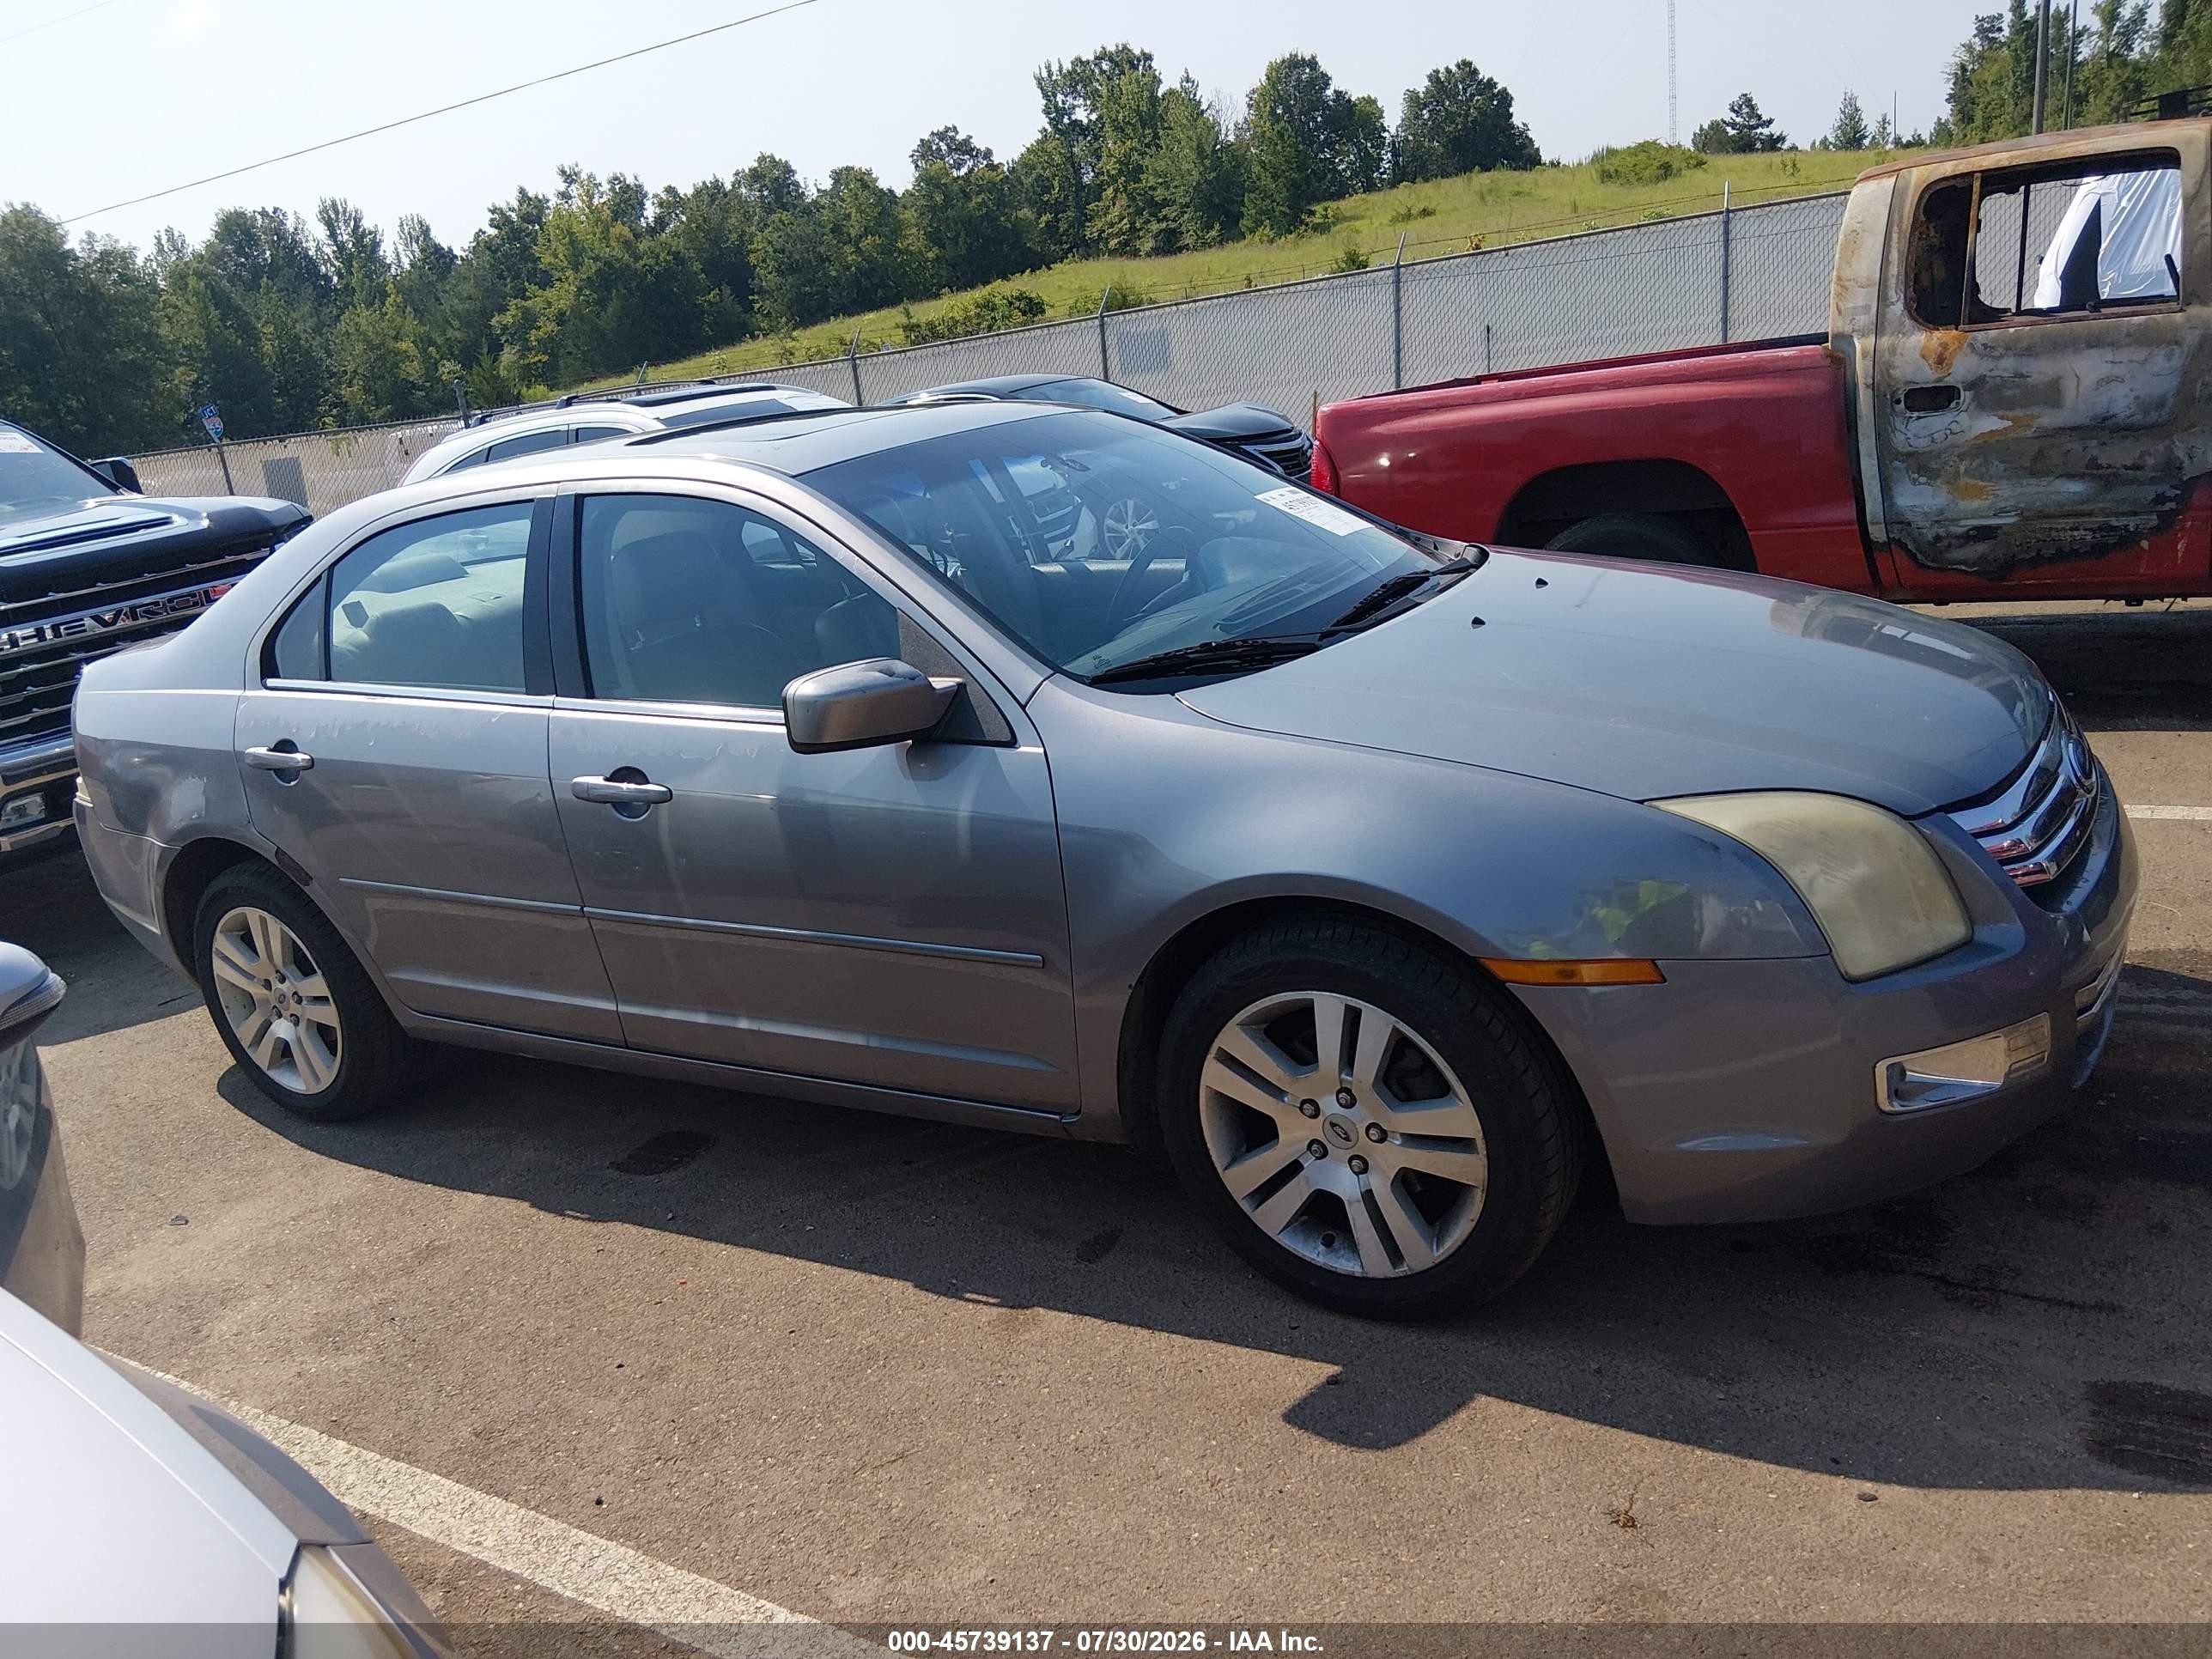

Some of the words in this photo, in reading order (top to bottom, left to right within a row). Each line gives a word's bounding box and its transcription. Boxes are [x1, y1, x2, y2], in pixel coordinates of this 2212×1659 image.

[204, 405, 216, 419] JCT
[209, 422, 222, 433] 55
[0, 583, 235, 653] HEVROL
